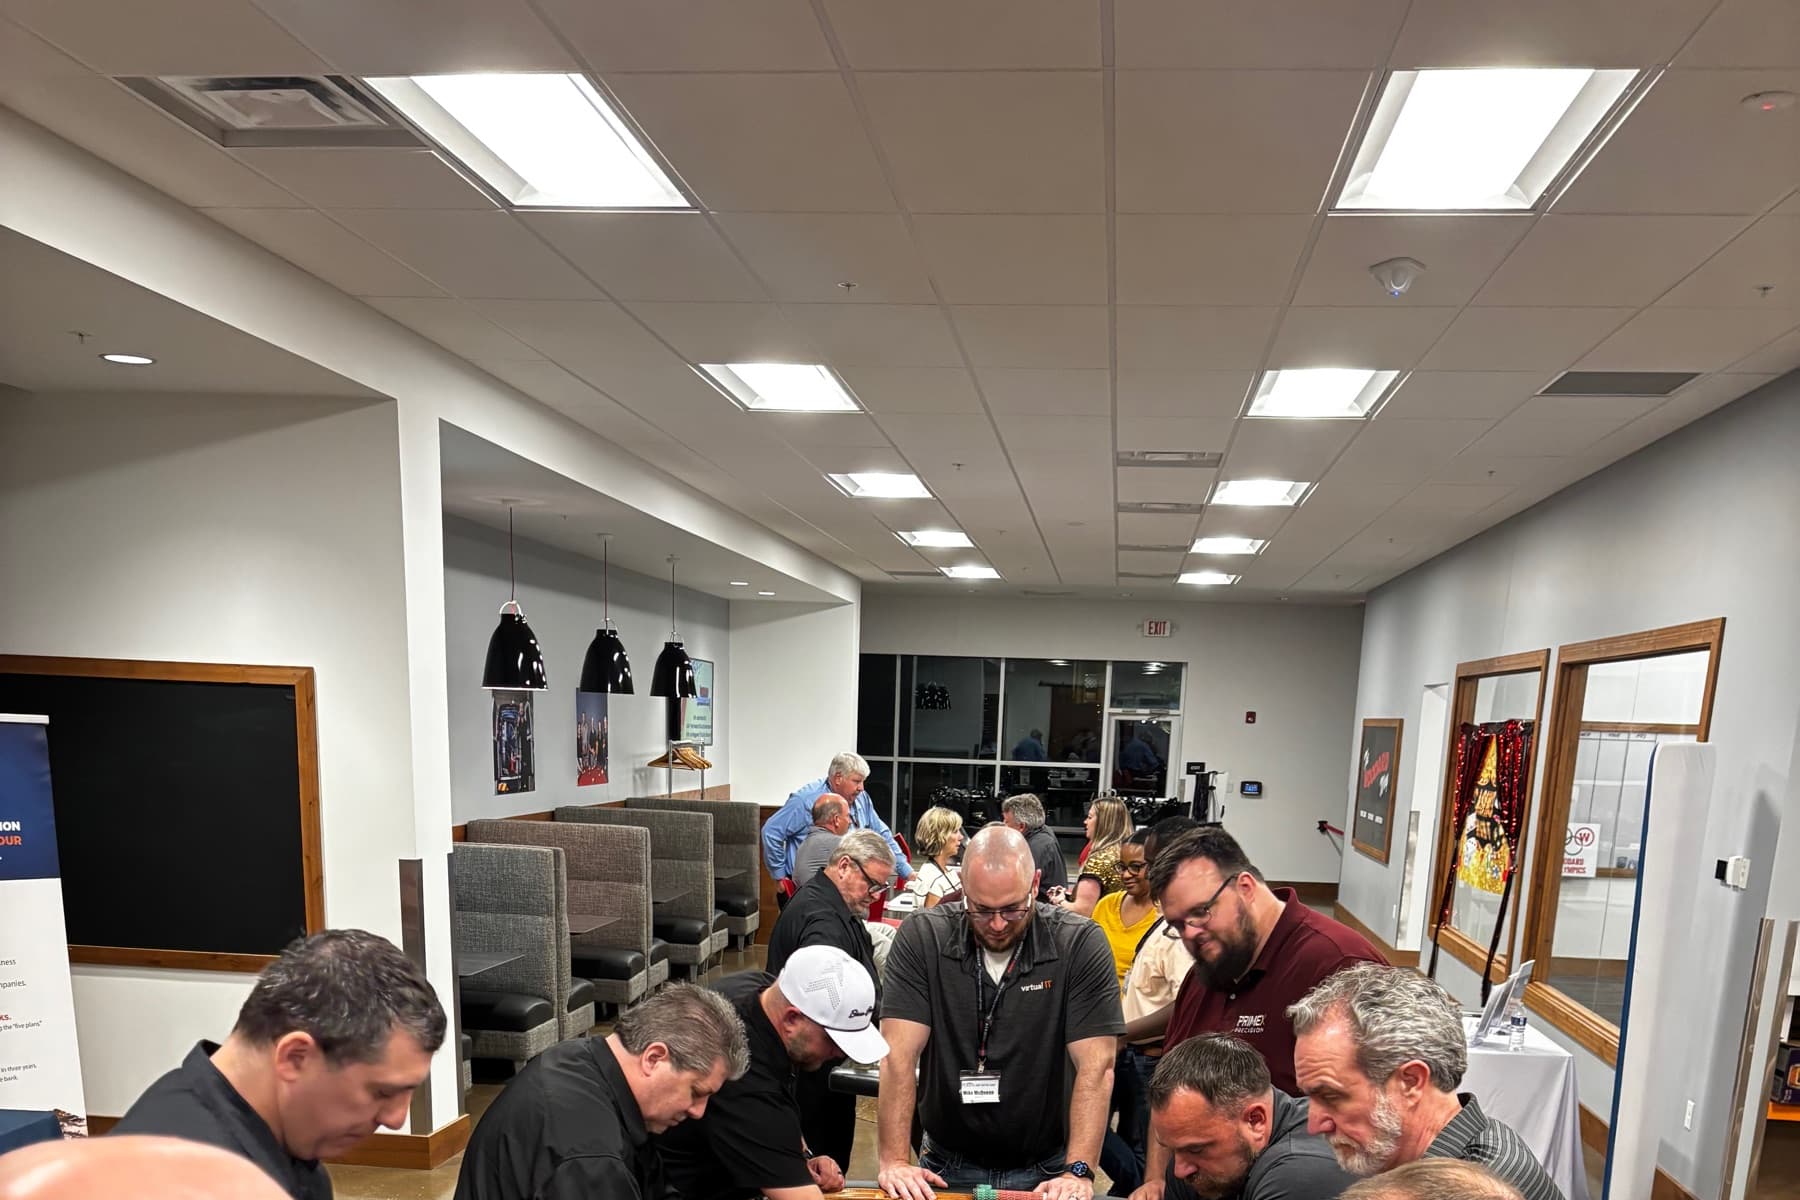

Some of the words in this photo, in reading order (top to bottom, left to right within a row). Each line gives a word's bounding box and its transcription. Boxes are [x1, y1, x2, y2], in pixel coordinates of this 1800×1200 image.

[1148, 621, 1167, 635] EXIT
[1021, 982, 1044, 992] virtual
[1236, 1014, 1264, 1027] PRIMEX
